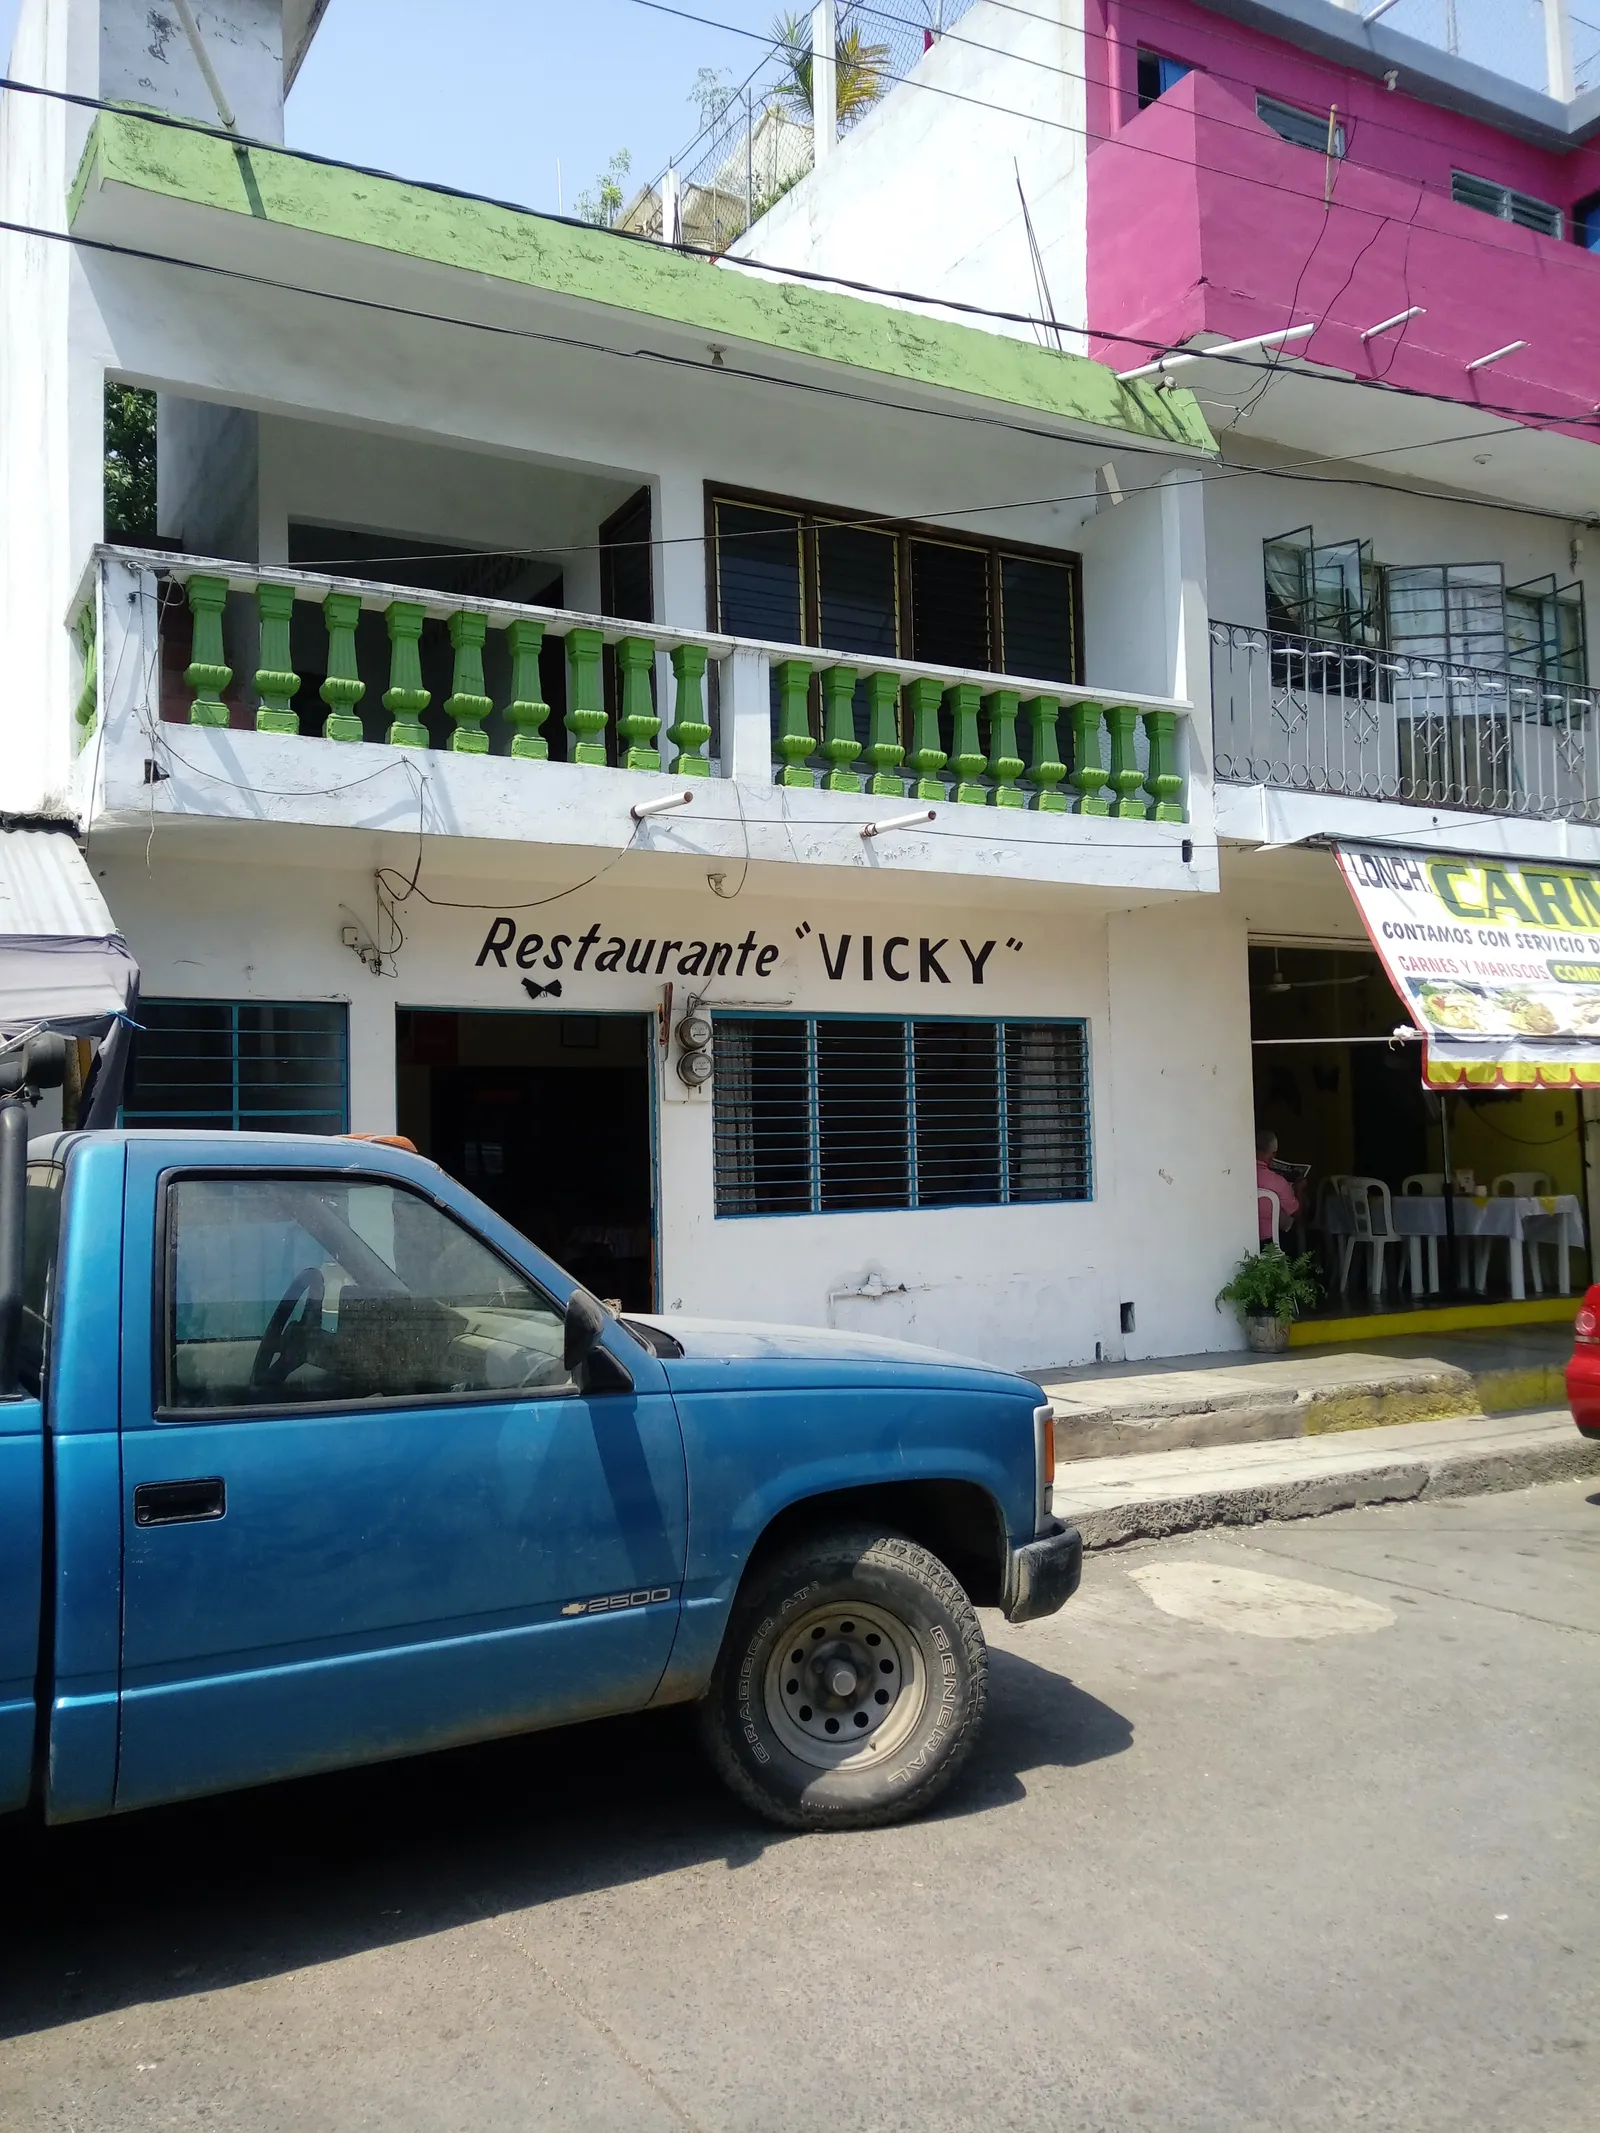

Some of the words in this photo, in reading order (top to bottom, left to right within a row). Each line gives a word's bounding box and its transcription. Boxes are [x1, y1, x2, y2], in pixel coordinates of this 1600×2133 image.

[475, 916, 780, 977] Restaurante
[1382, 921, 1473, 945] CONTAMOS
[1478, 930, 1511, 948] CON
[1515, 932, 1585, 954] SERVICIO
[1588, 938, 1600, 954] D
[1398, 955, 1459, 974] CARNES
[1460, 959, 1472, 974] Y
[1473, 960, 1550, 980] MARISCOS
[588, 1587, 671, 1613] 2500
[739, 1617, 774, 1764] GRABBER
[888, 1624, 957, 1783] GENERAL
